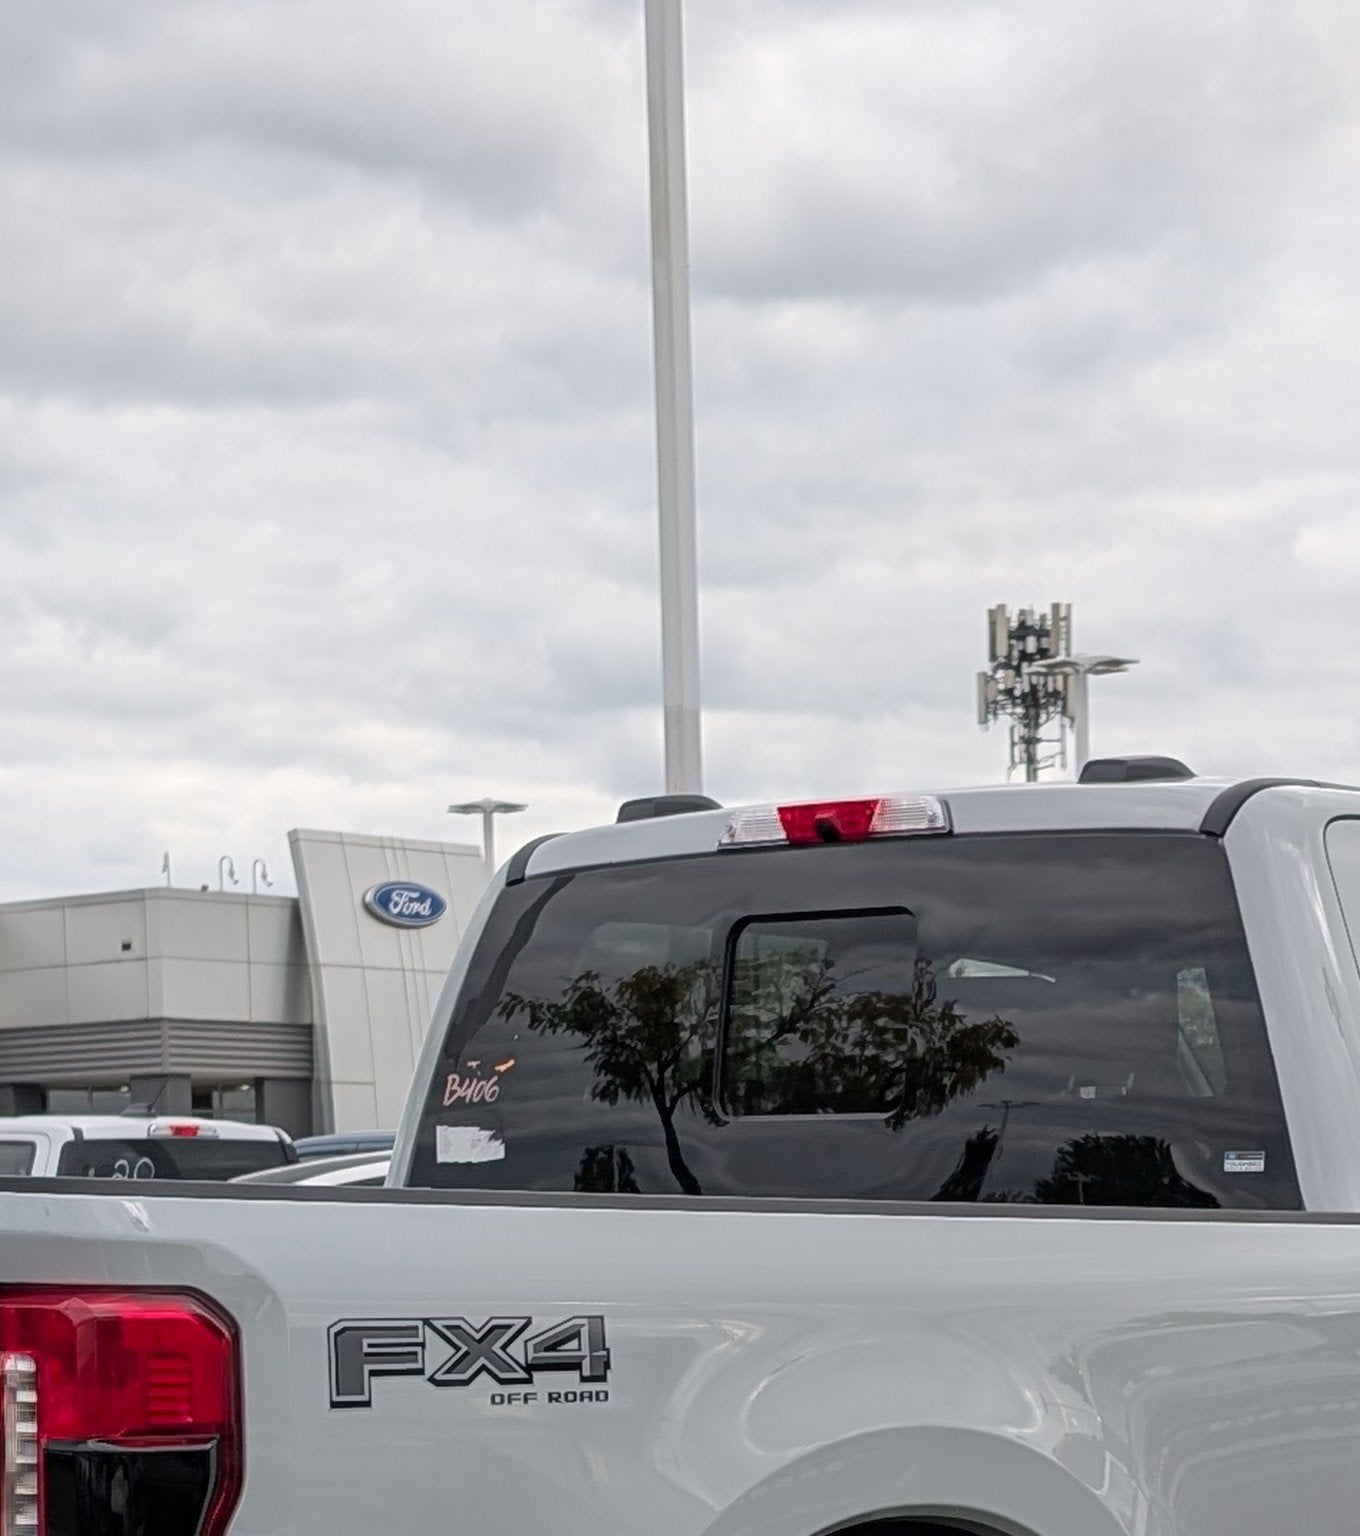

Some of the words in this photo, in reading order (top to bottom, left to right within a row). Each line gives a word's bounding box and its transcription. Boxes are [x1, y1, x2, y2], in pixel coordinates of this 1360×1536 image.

[388, 890, 432, 916] Ford
[443, 1073, 500, 1107] B406
[327, 1315, 611, 1409] FX4
[490, 1391, 538, 1406] OFF
[547, 1389, 610, 1404] ROAD
